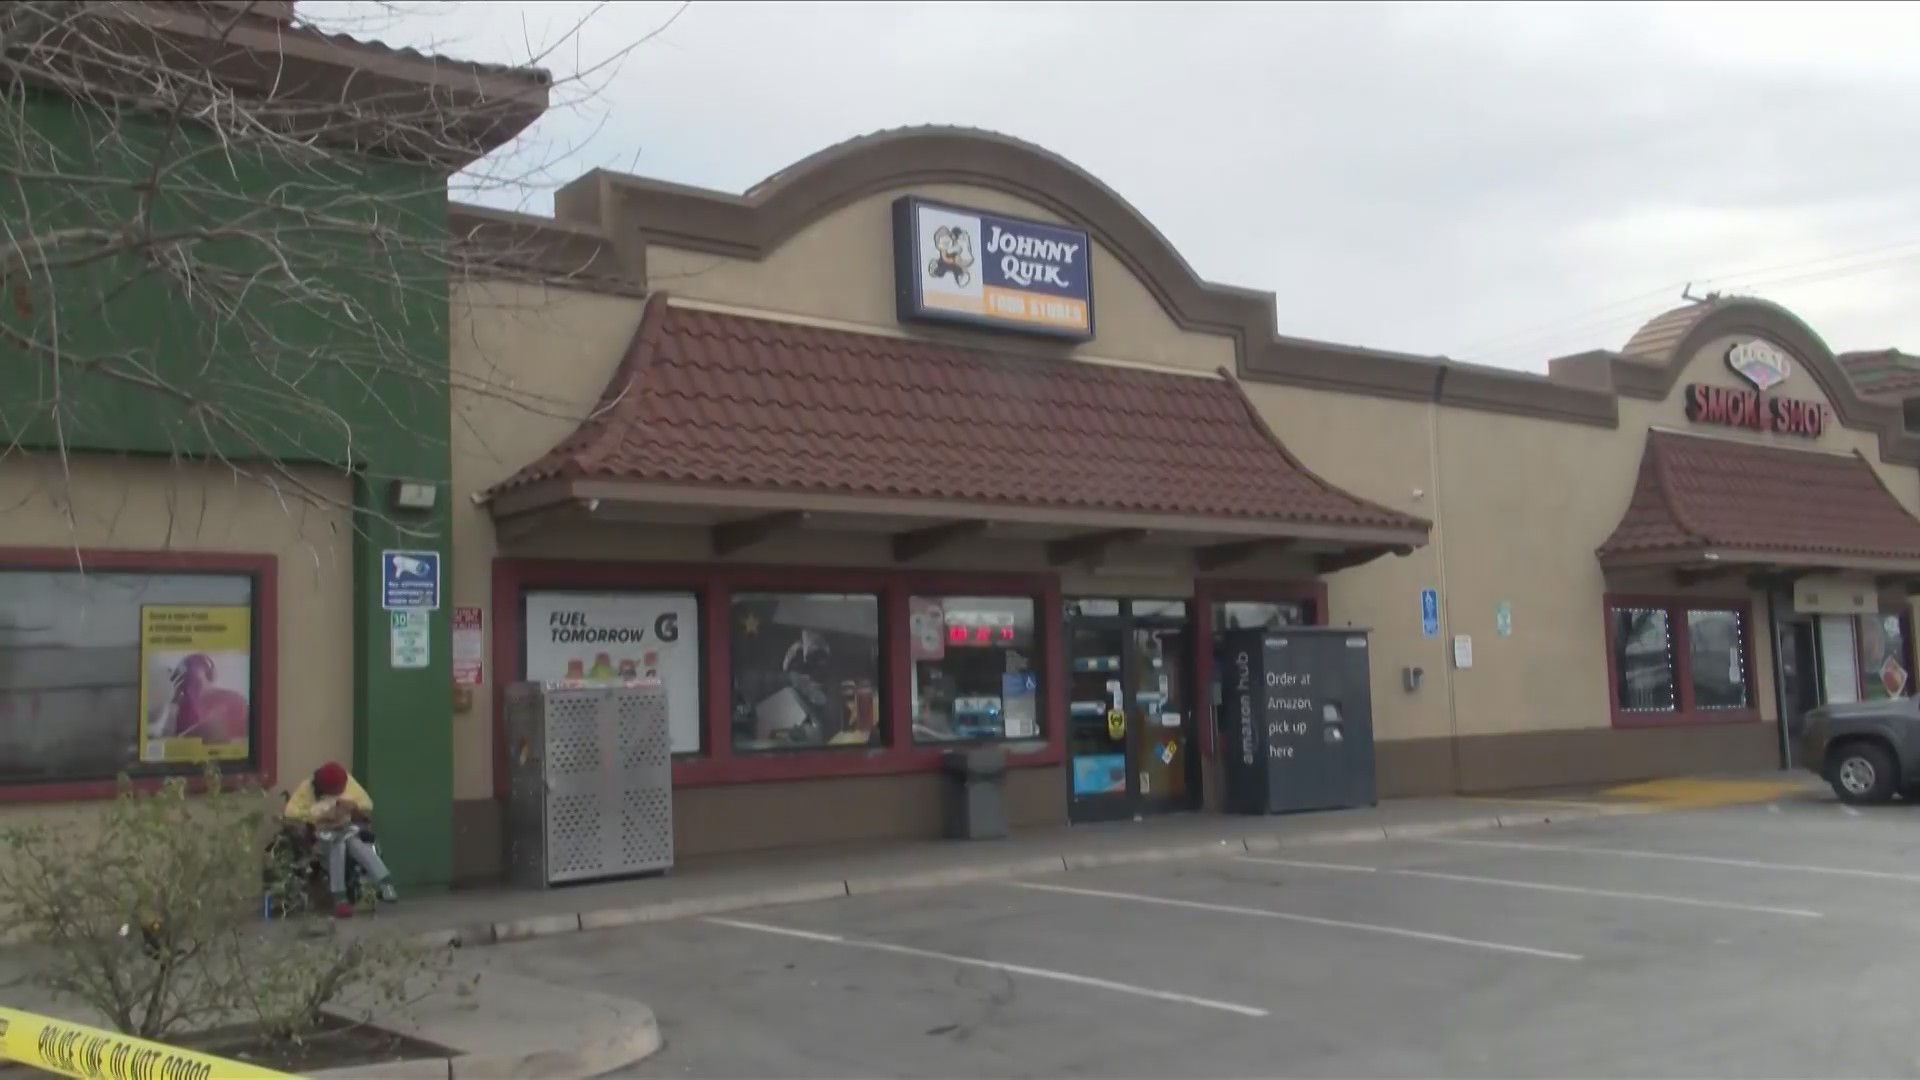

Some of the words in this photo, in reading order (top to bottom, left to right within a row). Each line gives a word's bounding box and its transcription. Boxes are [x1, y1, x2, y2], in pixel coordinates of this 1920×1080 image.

[987, 226, 1079, 263] JOHNNY
[1001, 255, 1069, 287] QUIK
[1691, 383, 1772, 430] SMOKE
[550, 611, 587, 626] FUEL
[654, 612, 678, 642] G
[551, 628, 644, 643] TOMORROW
[1236, 651, 1249, 690] hub
[1266, 672, 1297, 686] Order
[1300, 673, 1311, 685] at
[1241, 695, 1253, 764] amazon
[1268, 720, 1289, 736] pick
[1292, 722, 1307, 735] up
[1269, 744, 1294, 758] here
